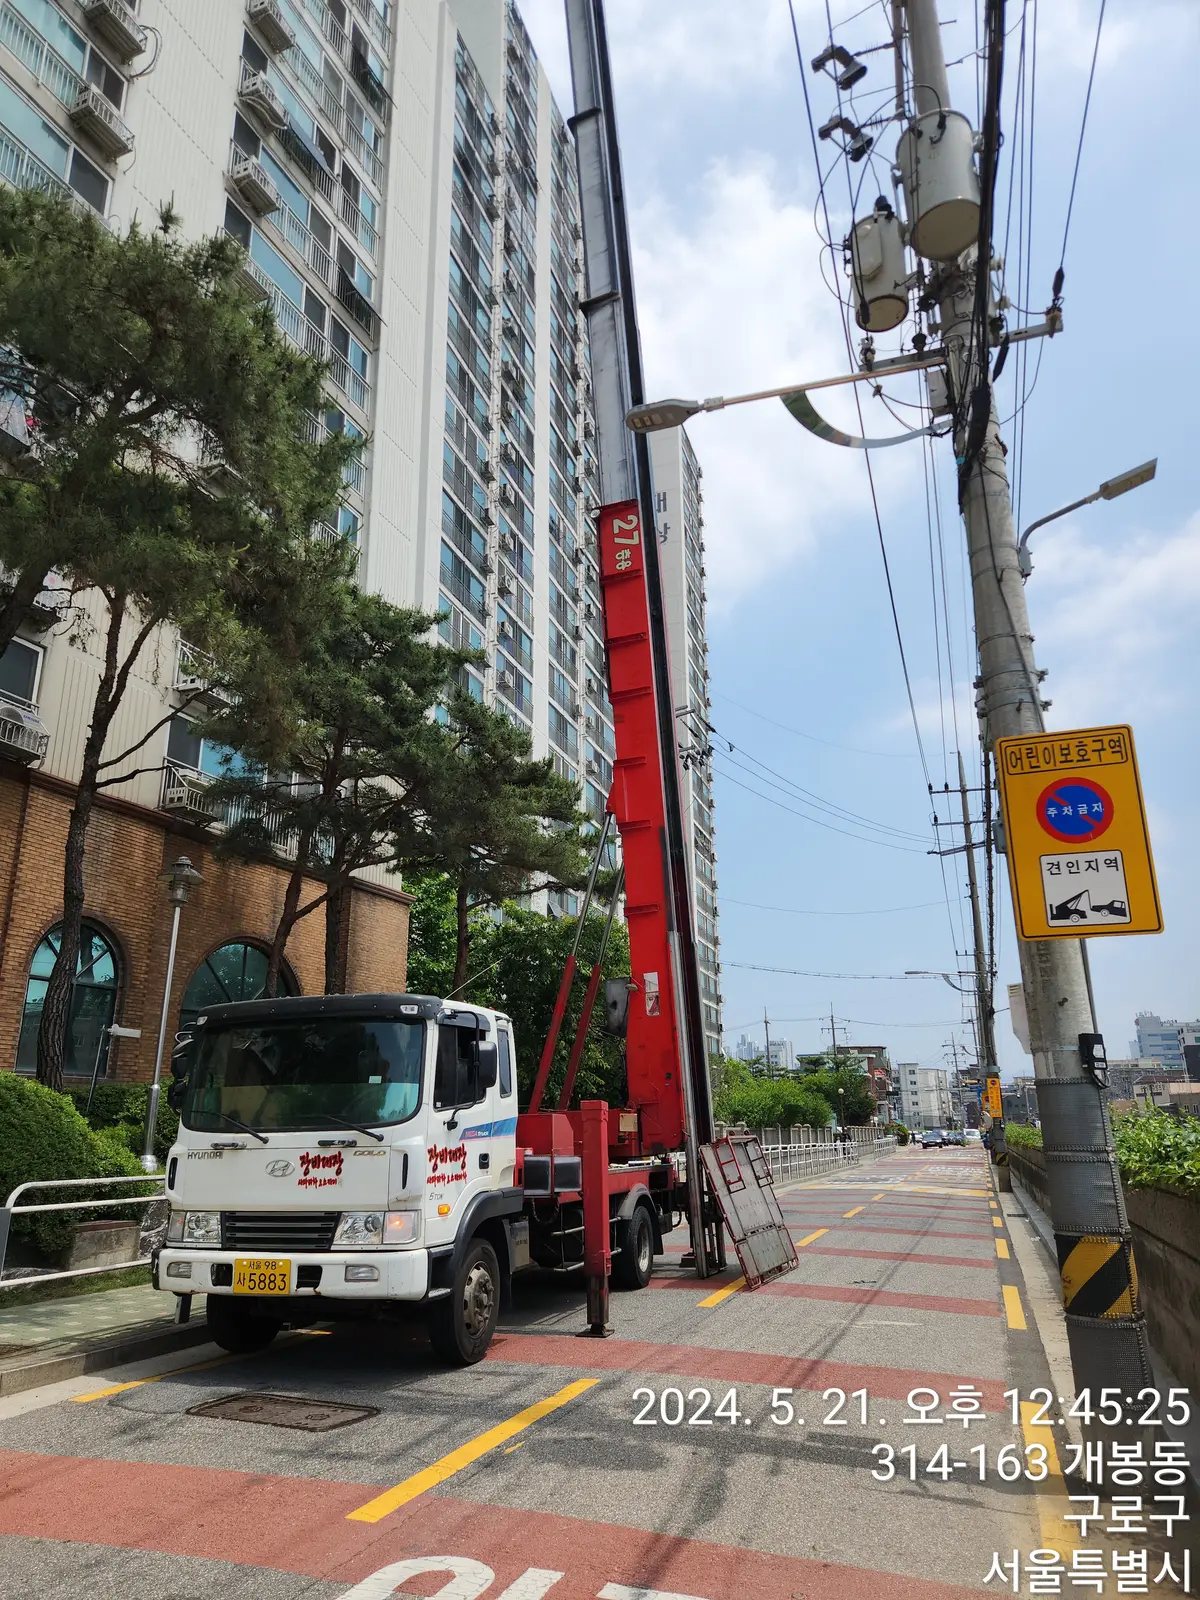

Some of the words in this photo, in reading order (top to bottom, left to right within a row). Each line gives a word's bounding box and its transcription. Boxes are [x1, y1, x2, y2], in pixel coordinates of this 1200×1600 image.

[1009, 736, 1124, 772] 어린이보호구역
[1046, 802, 1104, 818] 주차금지
[1046, 857, 1120, 876] 견인지역
[187, 1151, 224, 1160] HYUNDAI
[248, 1261, 262, 1270] 서울
[264, 1261, 277, 1270] 98
